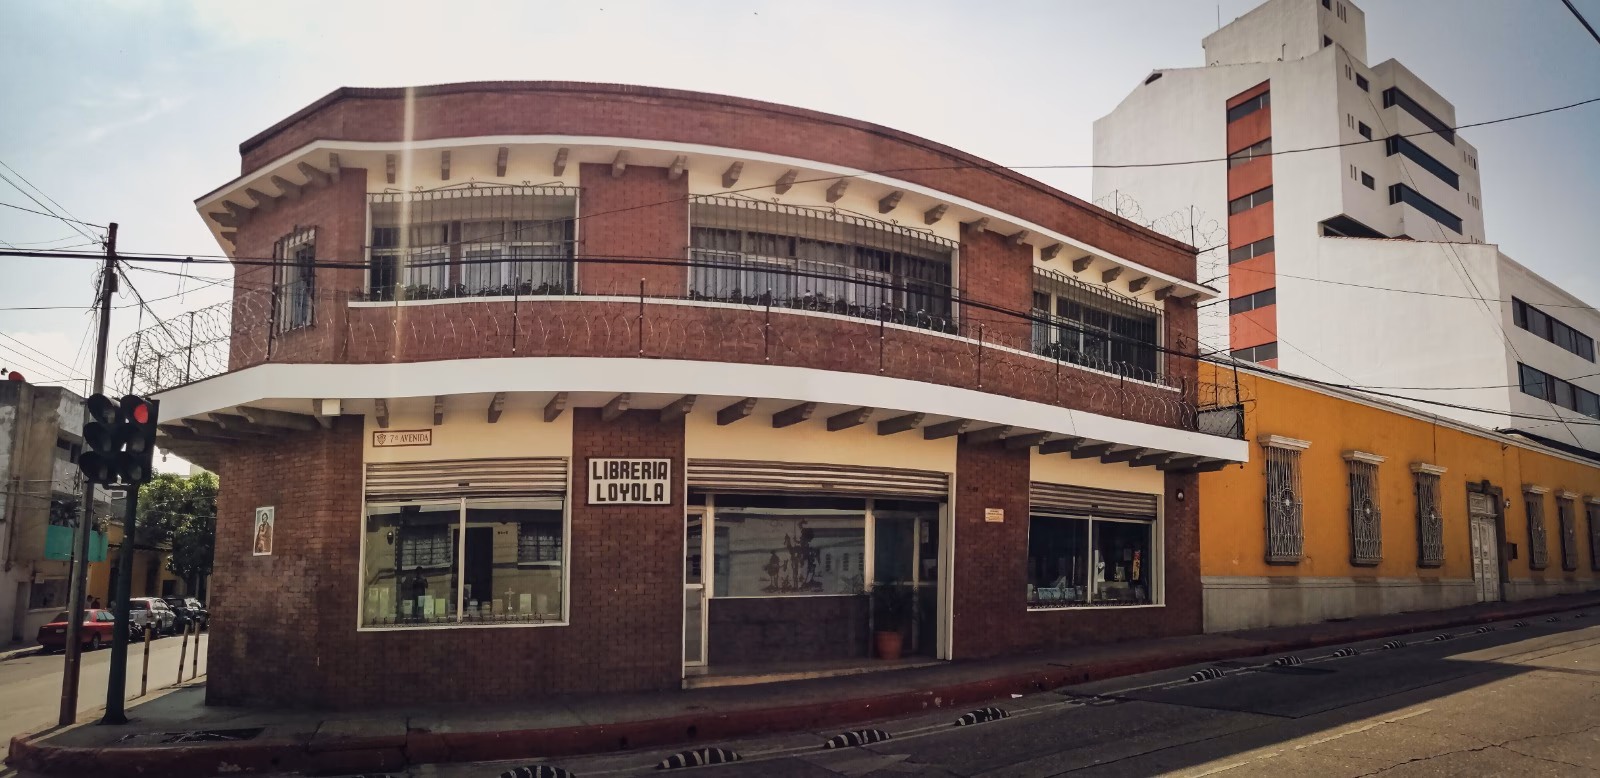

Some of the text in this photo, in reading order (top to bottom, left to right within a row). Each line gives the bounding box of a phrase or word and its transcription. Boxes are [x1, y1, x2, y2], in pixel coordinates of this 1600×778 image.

[400, 433, 429, 443] AVENIDA
[592, 461, 668, 480] LIBRERIA
[596, 483, 664, 502] LOYOLA
